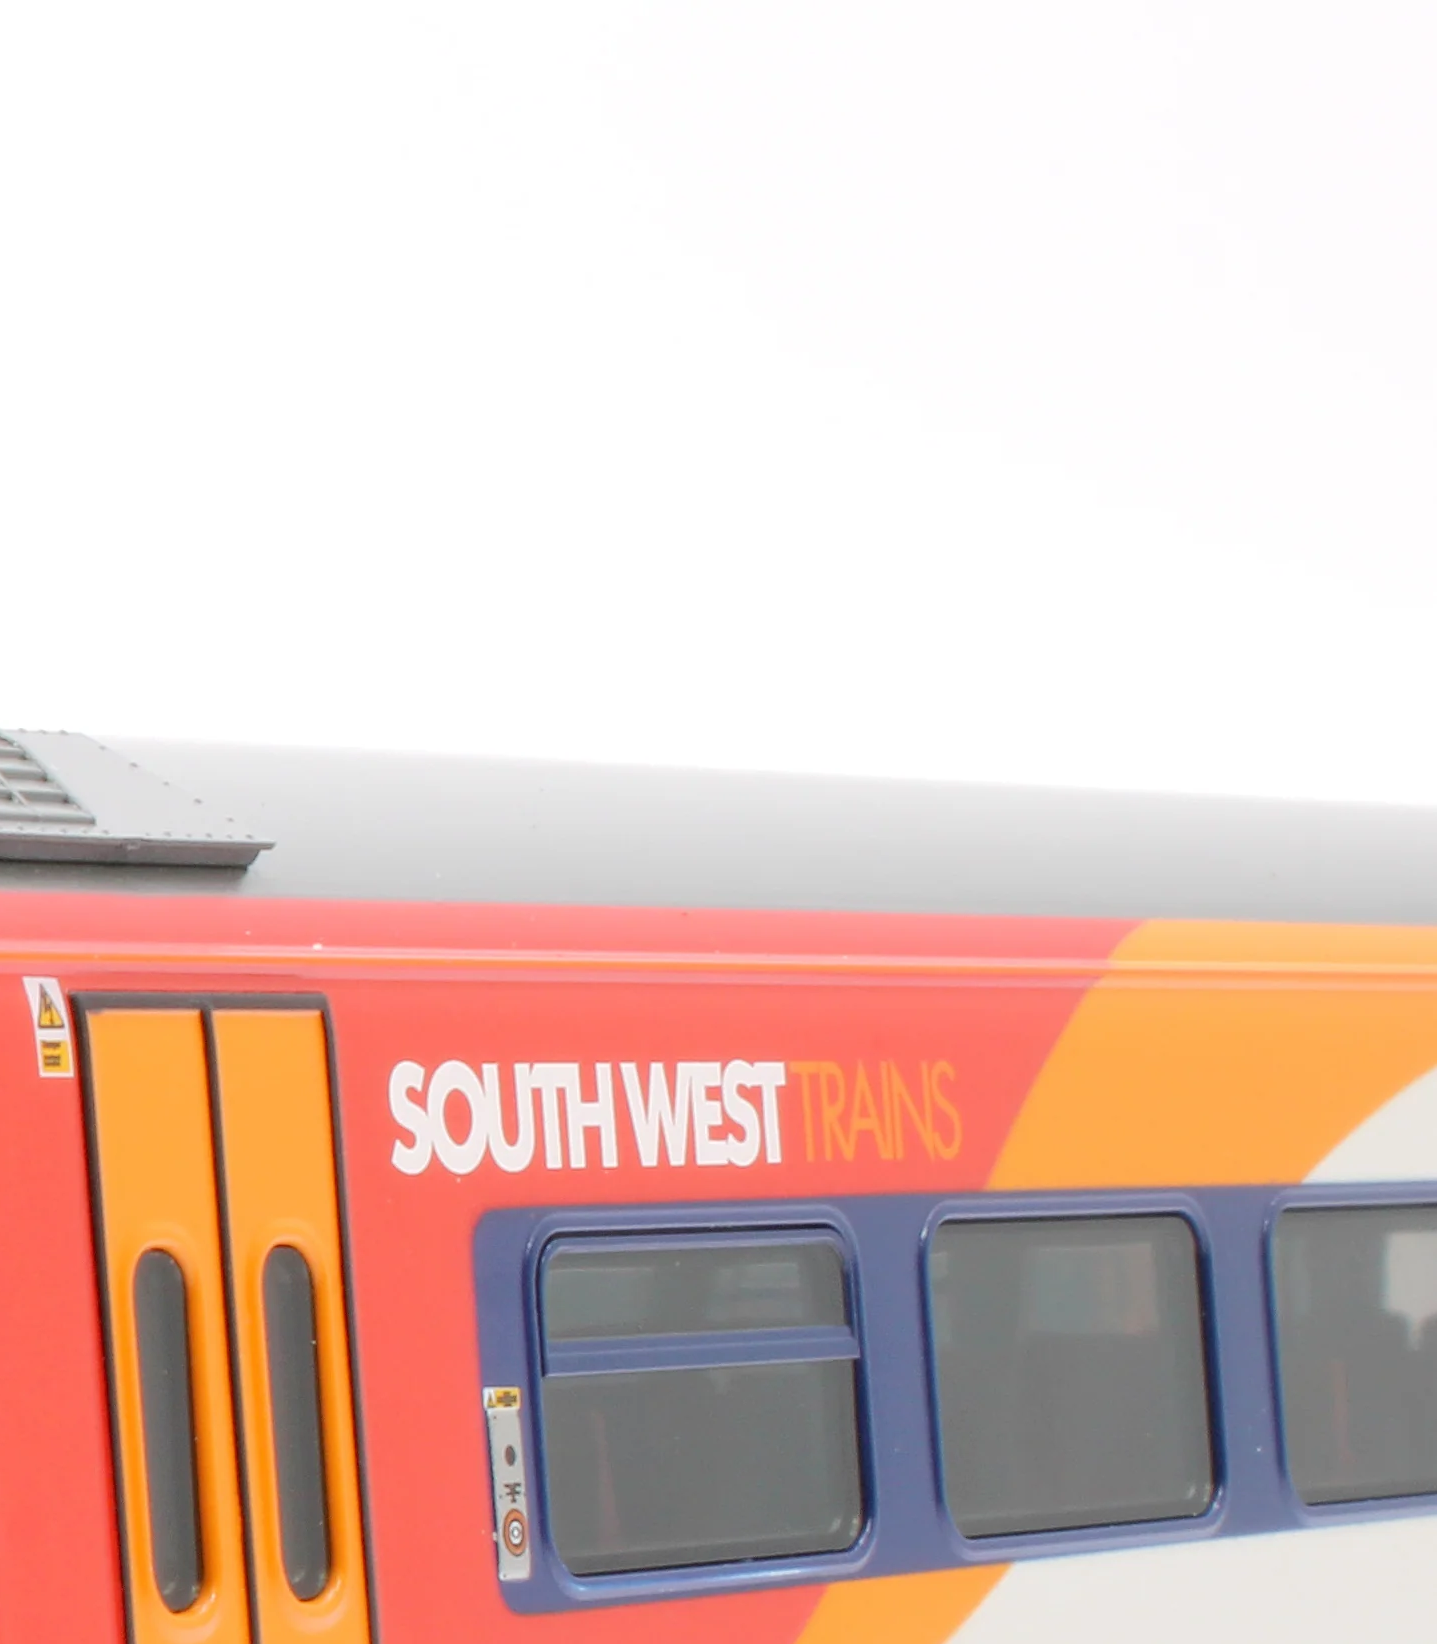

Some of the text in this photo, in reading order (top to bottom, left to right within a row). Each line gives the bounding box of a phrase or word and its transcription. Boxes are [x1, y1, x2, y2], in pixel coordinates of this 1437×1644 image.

[389, 1059, 963, 1176] SOUTH WEST TRAINS
